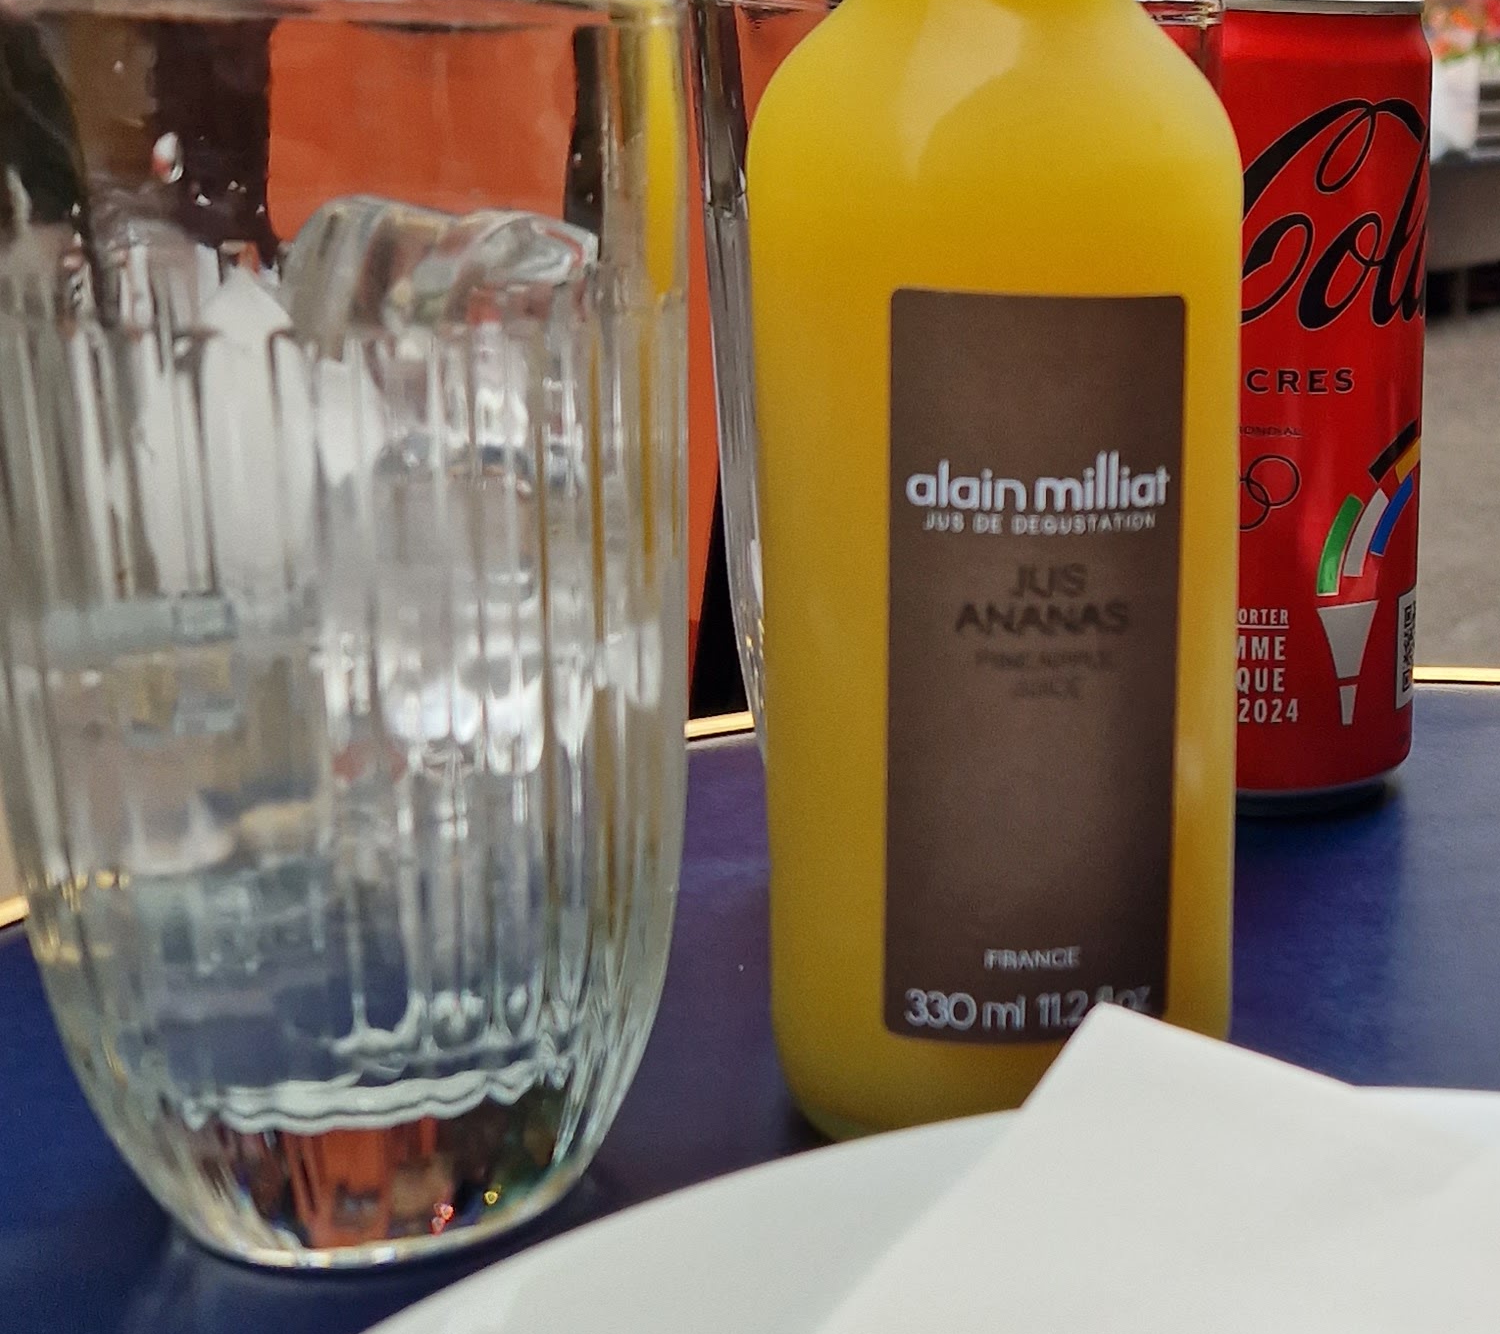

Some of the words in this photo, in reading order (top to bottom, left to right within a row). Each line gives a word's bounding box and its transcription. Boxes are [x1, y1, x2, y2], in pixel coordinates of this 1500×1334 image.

[1240, 98, 1430, 331] Col
[1246, 369, 1354, 394] CRES
[906, 459, 1026, 513] alain
[1034, 450, 1170, 513] milliat
[923, 512, 965, 534] JUS
[973, 515, 1003, 535] DE
[1011, 563, 1086, 599] JUS
[956, 601, 1129, 636] ANANAS
[1237, 608, 1289, 625] ORTER
[1236, 667, 1285, 694] QUE
[1238, 697, 1299, 723] 2024
[984, 946, 1082, 971] FRANCE
[904, 988, 977, 1031] 330
[982, 994, 1027, 1031] ml
